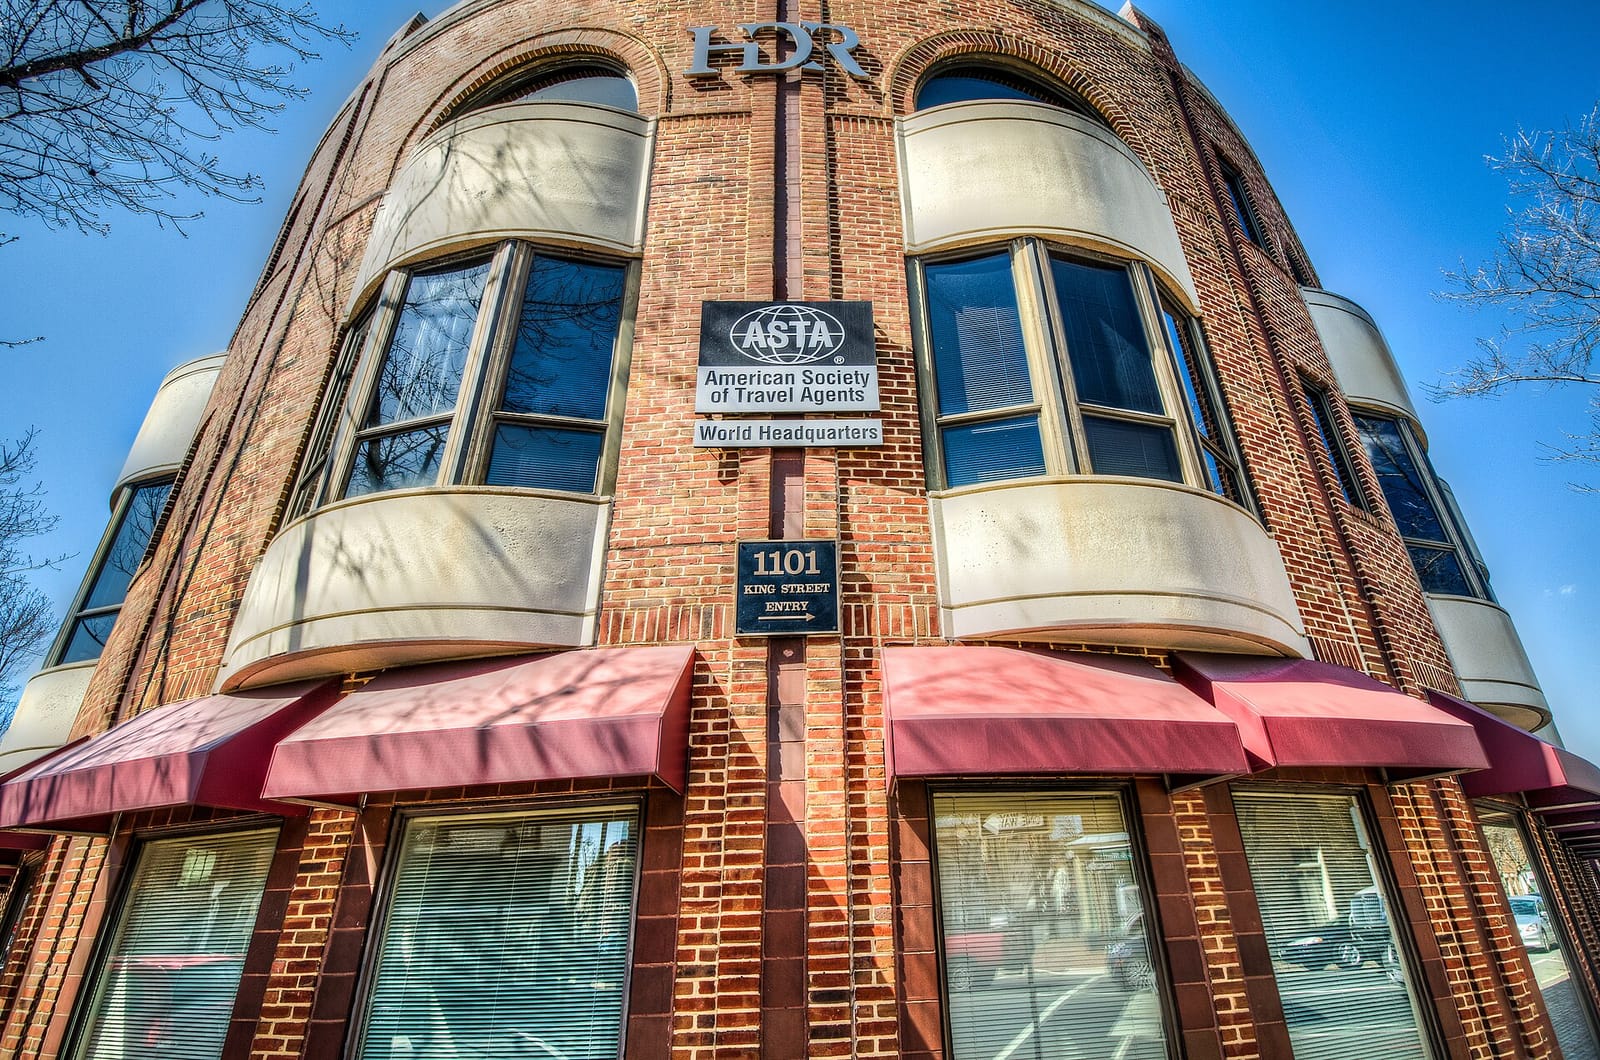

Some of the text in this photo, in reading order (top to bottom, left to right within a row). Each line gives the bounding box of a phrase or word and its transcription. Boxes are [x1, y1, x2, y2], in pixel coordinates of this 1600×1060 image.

[683, 21, 870, 79] HDR
[742, 321, 833, 348] ASTA
[704, 369, 870, 388] American Society
[710, 387, 865, 405] of Travel Agents
[699, 425, 878, 443] World Headquarters
[753, 550, 820, 575] 1101
[743, 583, 831, 595] KING STREET
[765, 601, 809, 612] ENTRY
